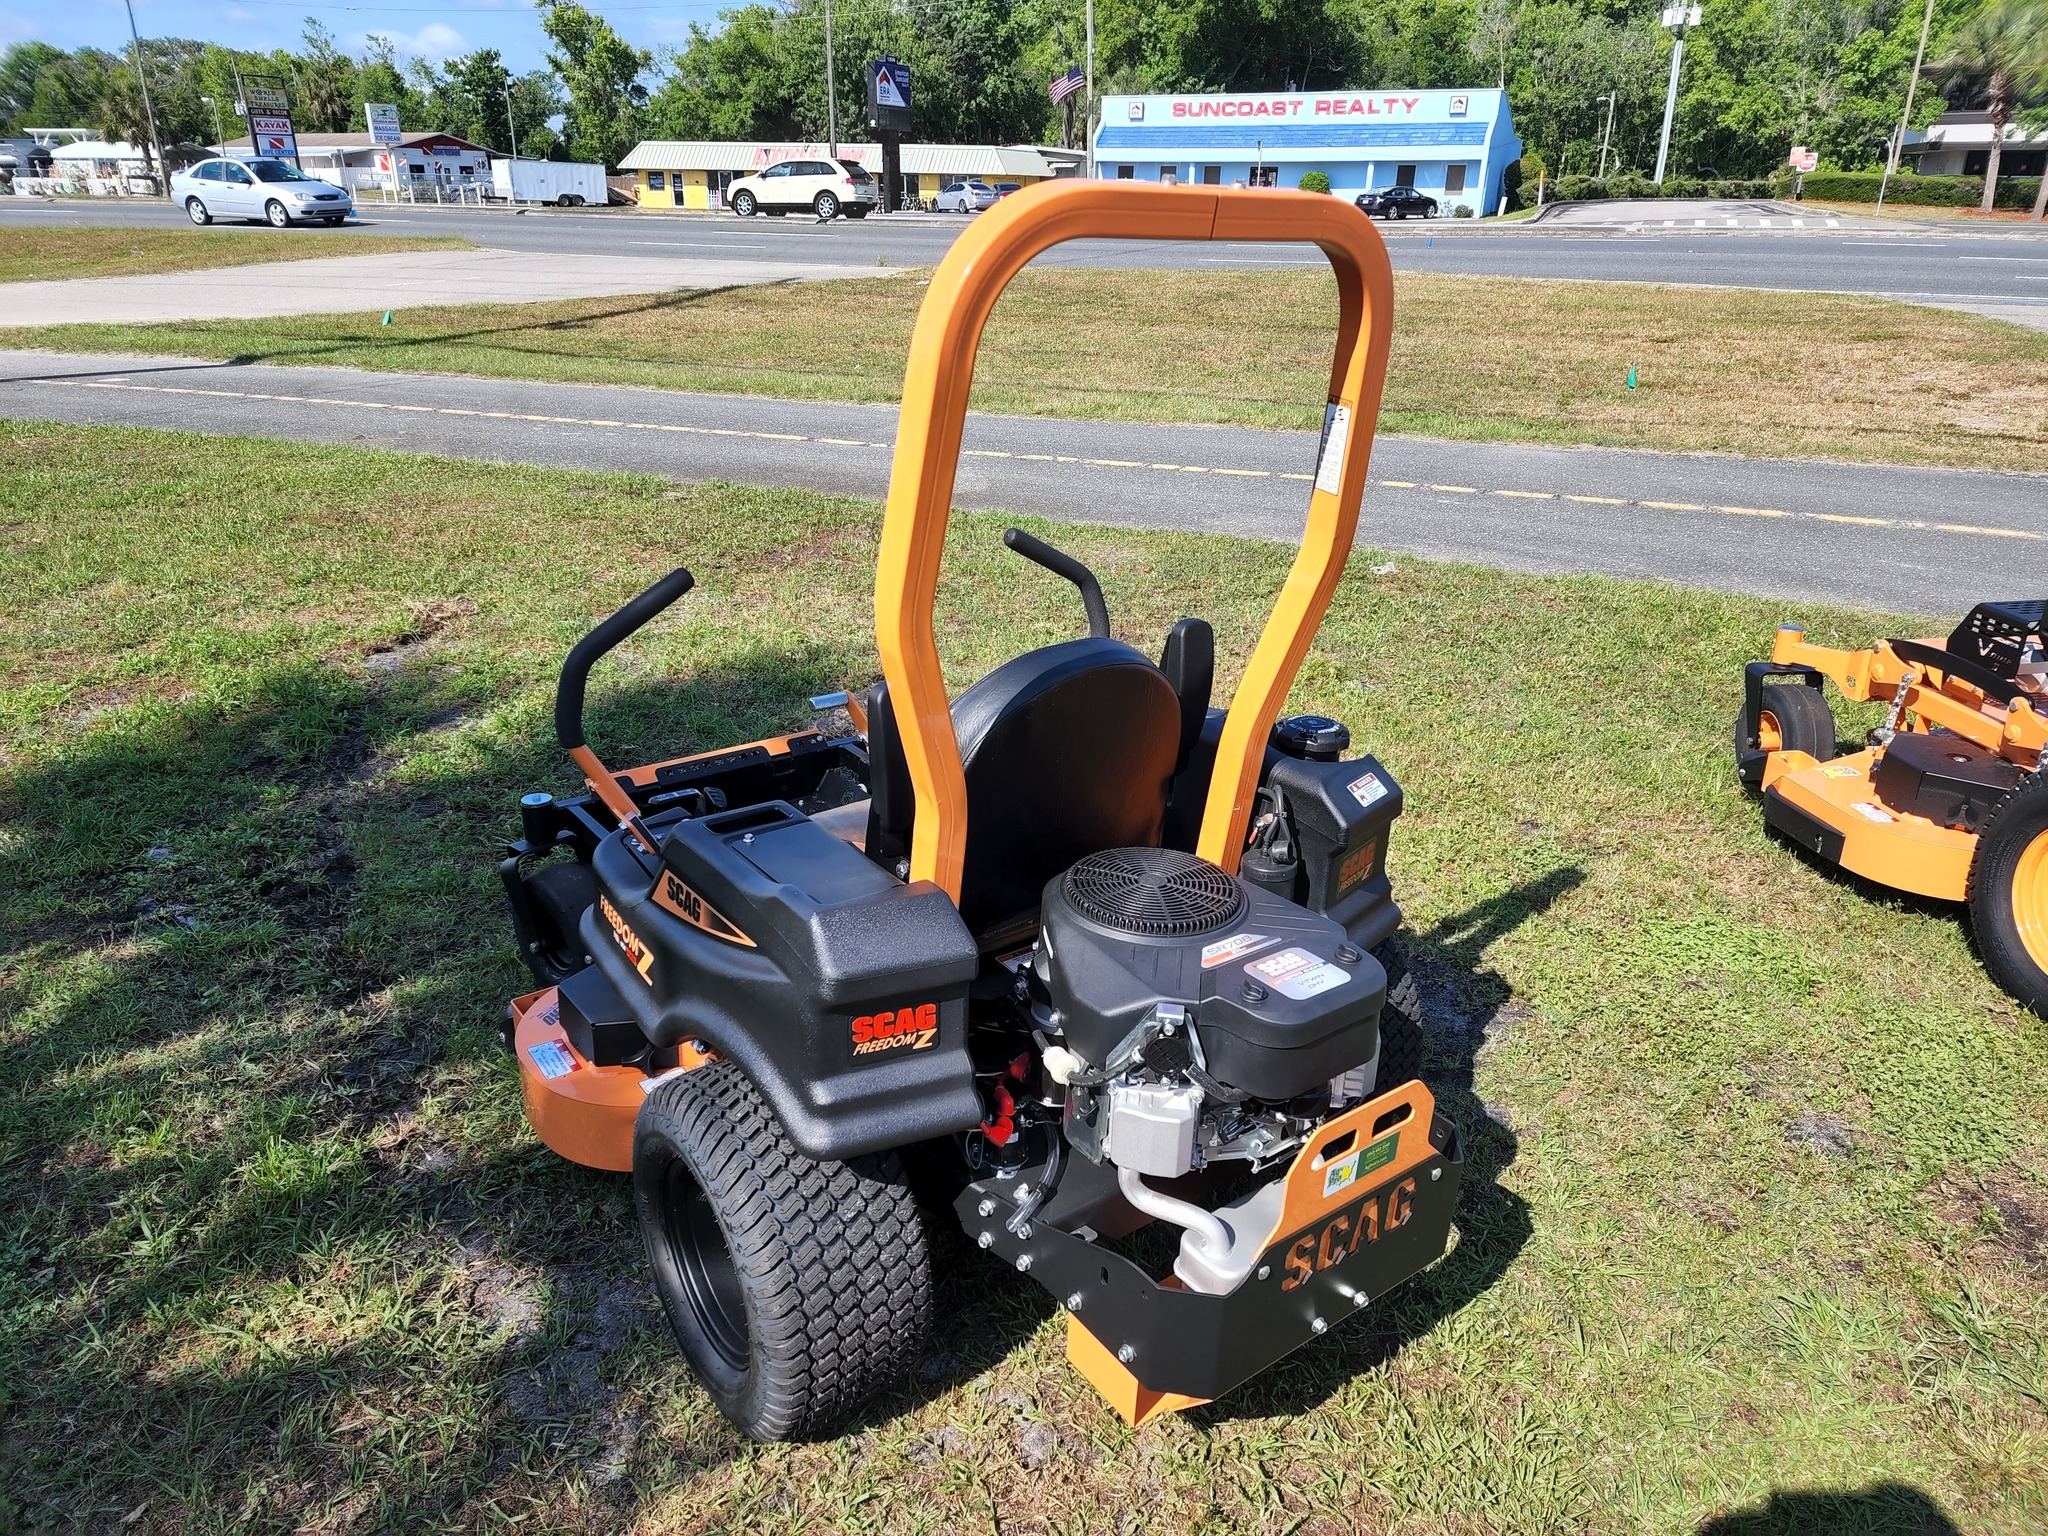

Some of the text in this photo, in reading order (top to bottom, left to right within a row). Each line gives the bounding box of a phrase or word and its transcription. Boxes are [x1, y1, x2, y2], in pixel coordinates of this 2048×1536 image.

[880, 86, 890, 96] ERA
[1172, 98, 1420, 117] SUNCOAST REALTY
[255, 120, 289, 130] KAYAK
[1340, 841, 1376, 881] SCAG
[667, 876, 702, 923] SCAG
[851, 1003, 937, 1044] SCAG
[1281, 1176, 1417, 1293] SCAG
